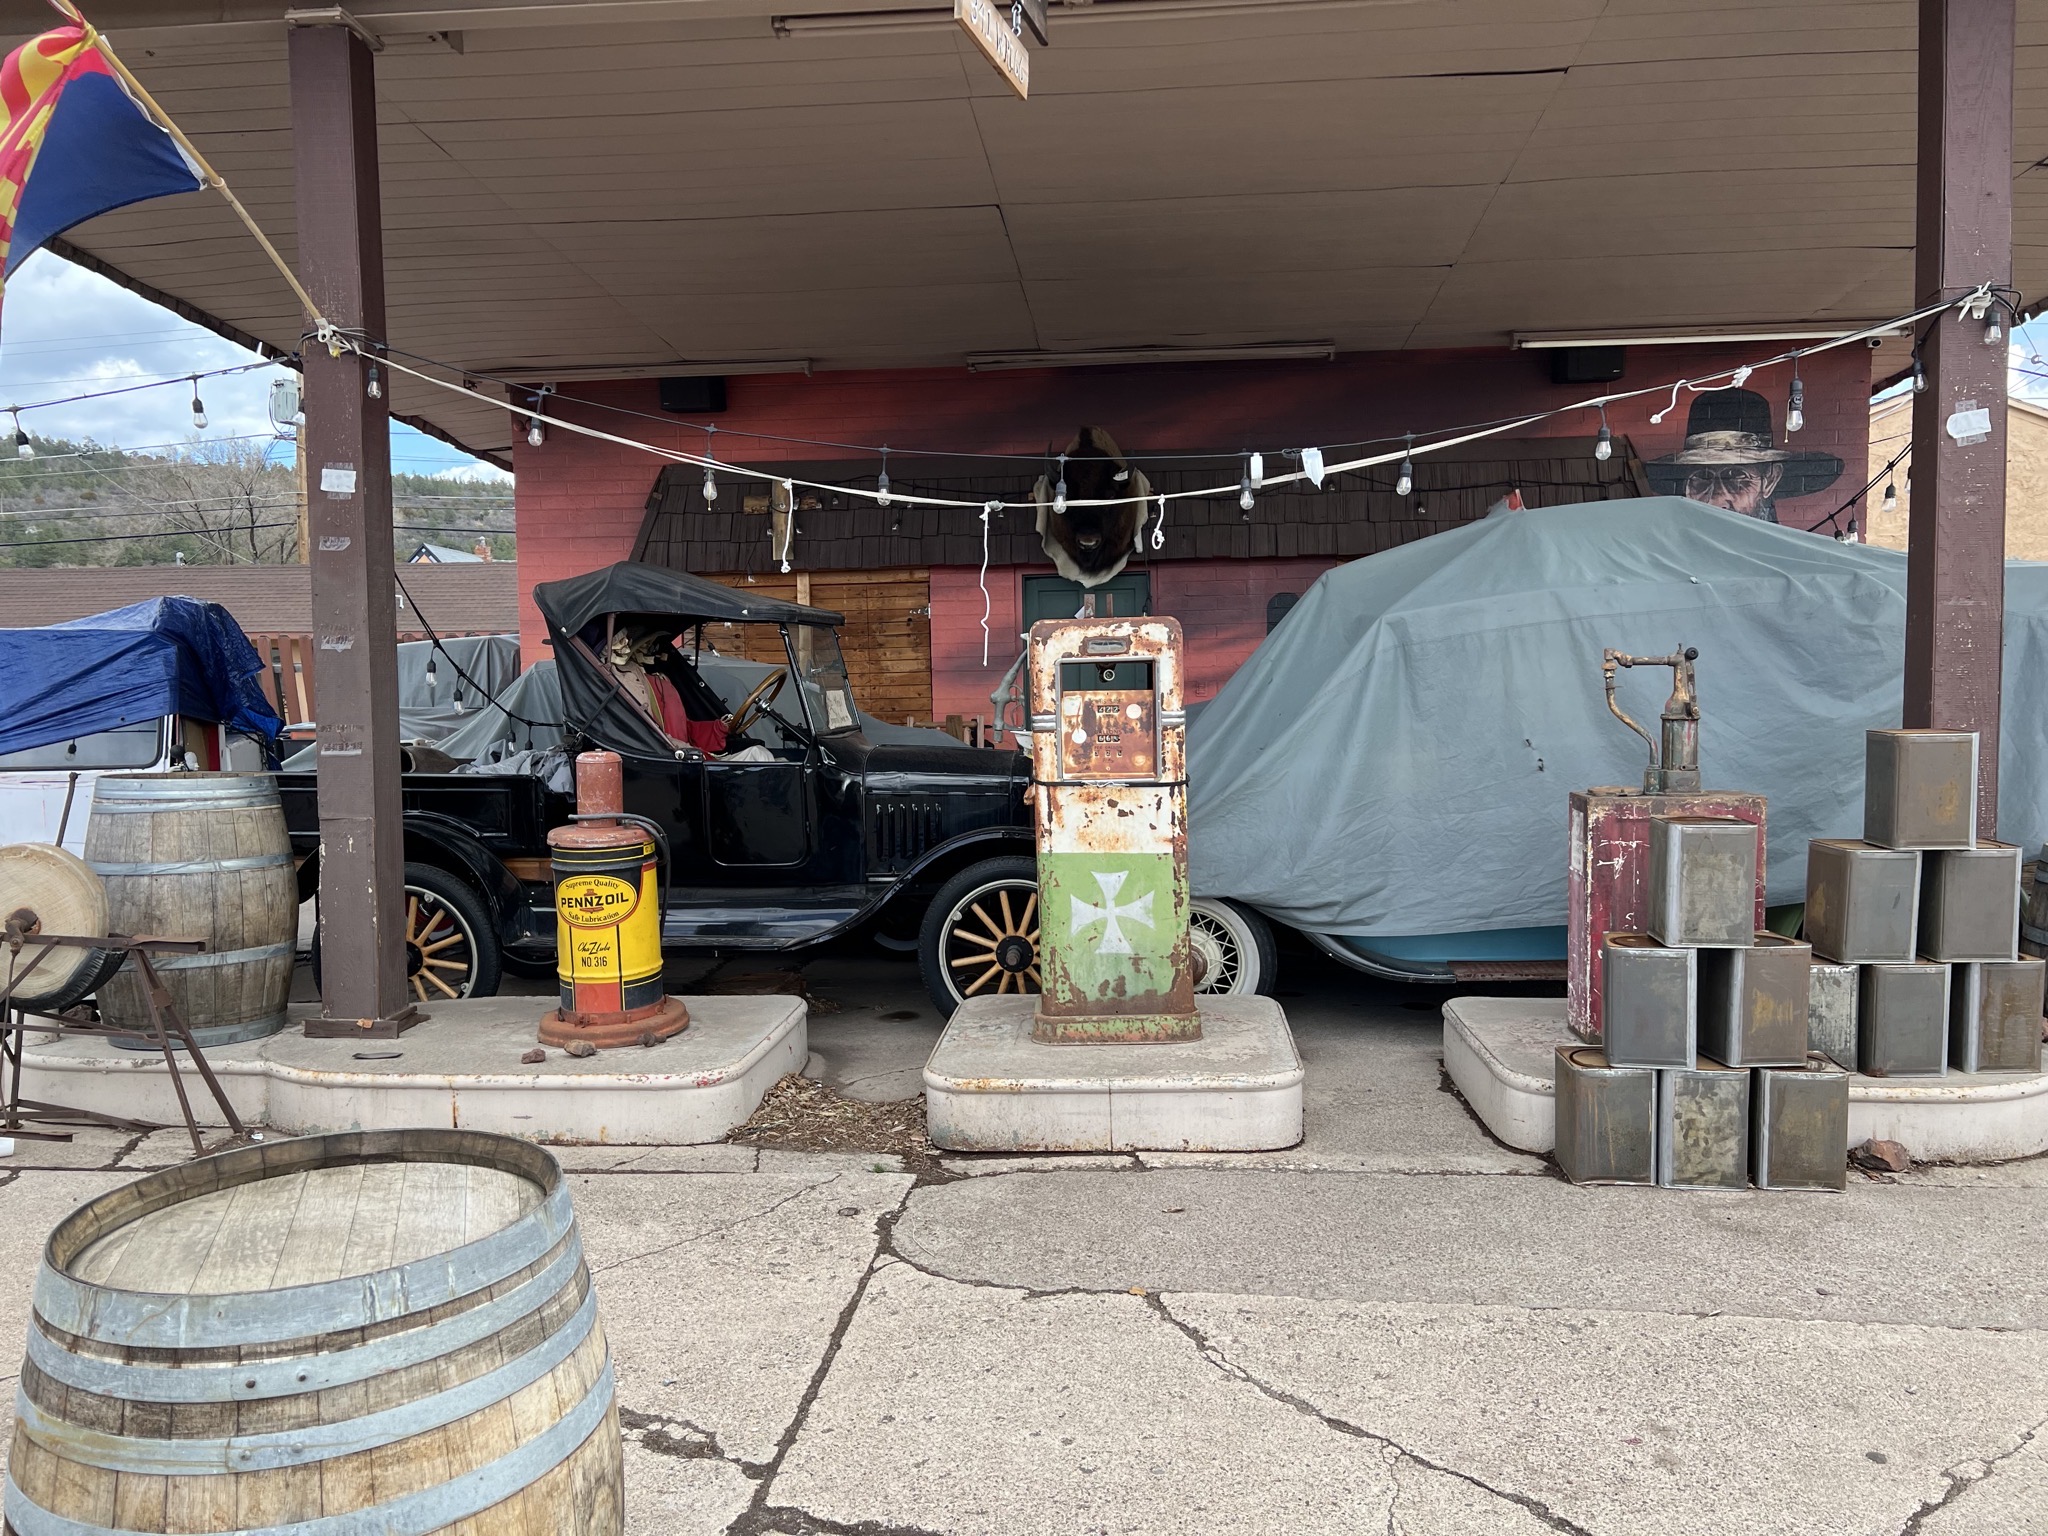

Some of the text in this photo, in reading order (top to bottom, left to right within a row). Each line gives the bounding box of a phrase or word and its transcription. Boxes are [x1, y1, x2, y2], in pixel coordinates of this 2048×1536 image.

[566, 879, 618, 890] Supreme Quality
[561, 892, 629, 908] PENNZOIL
[568, 911, 620, 922] Safe Lubrication
[594, 956, 607, 967] 316
